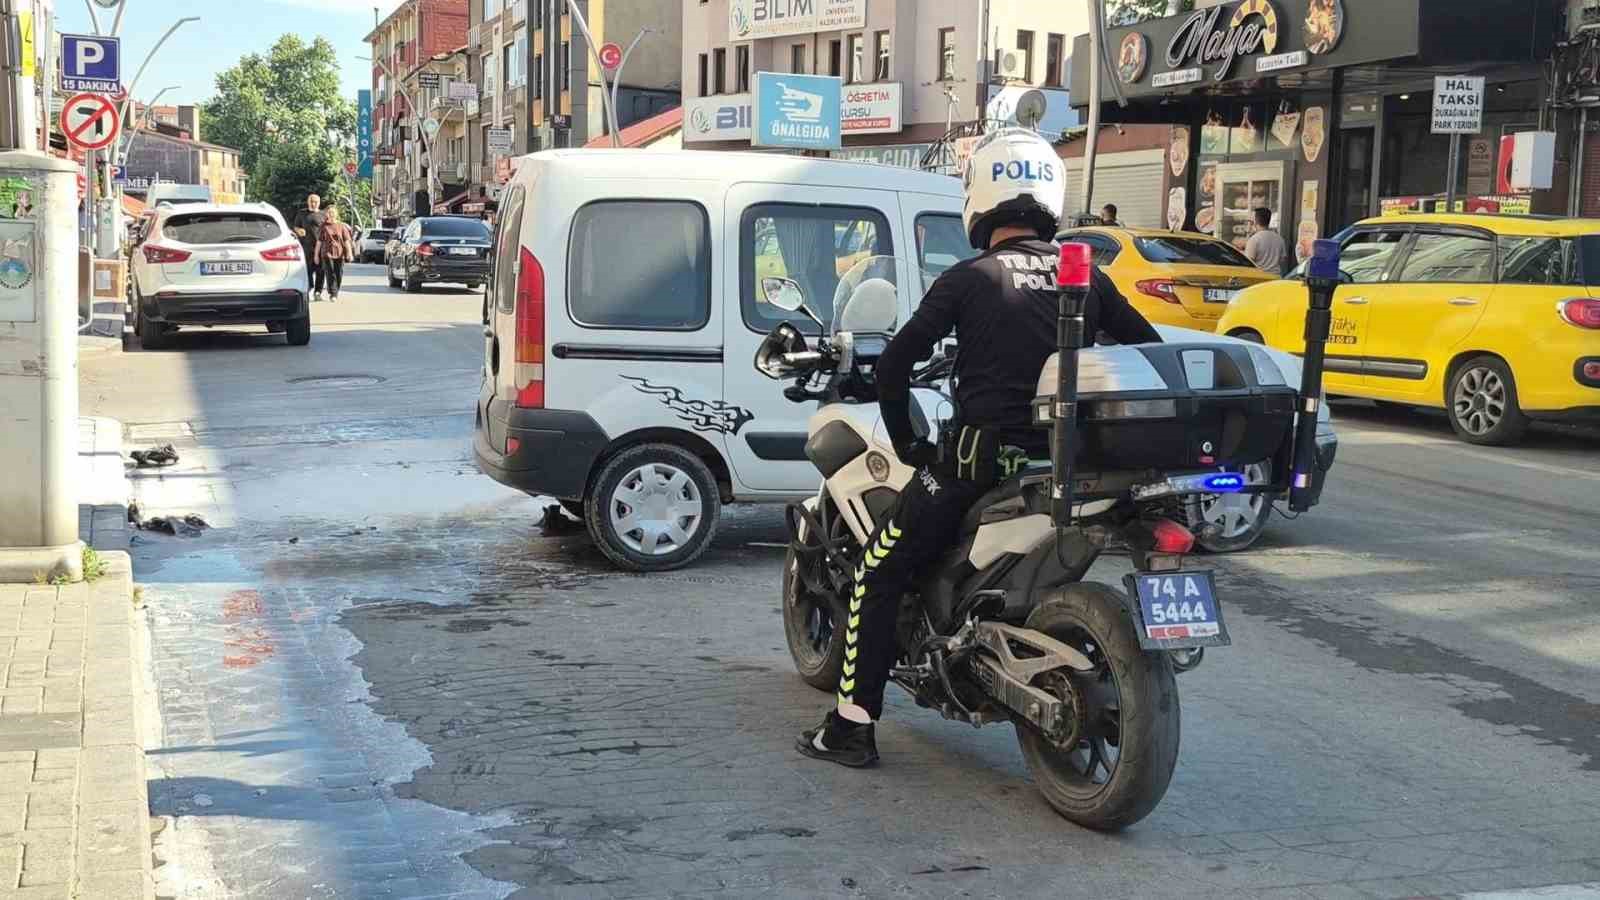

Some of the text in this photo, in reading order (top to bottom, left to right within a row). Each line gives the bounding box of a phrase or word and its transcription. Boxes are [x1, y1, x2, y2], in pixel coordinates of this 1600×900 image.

[1166, 5, 1266, 81] Maya
[76, 40, 104, 75] P
[63, 79, 75, 89] 15
[1446, 79, 1473, 91] HAL
[1439, 92, 1479, 105] TAKSİ
[771, 120, 830, 140] ÖNALGIDA
[1434, 120, 1451, 129] PARK
[997, 254, 1058, 271] TRAF
[1148, 577, 1200, 598] 74 A
[1151, 602, 1207, 623] 5444
